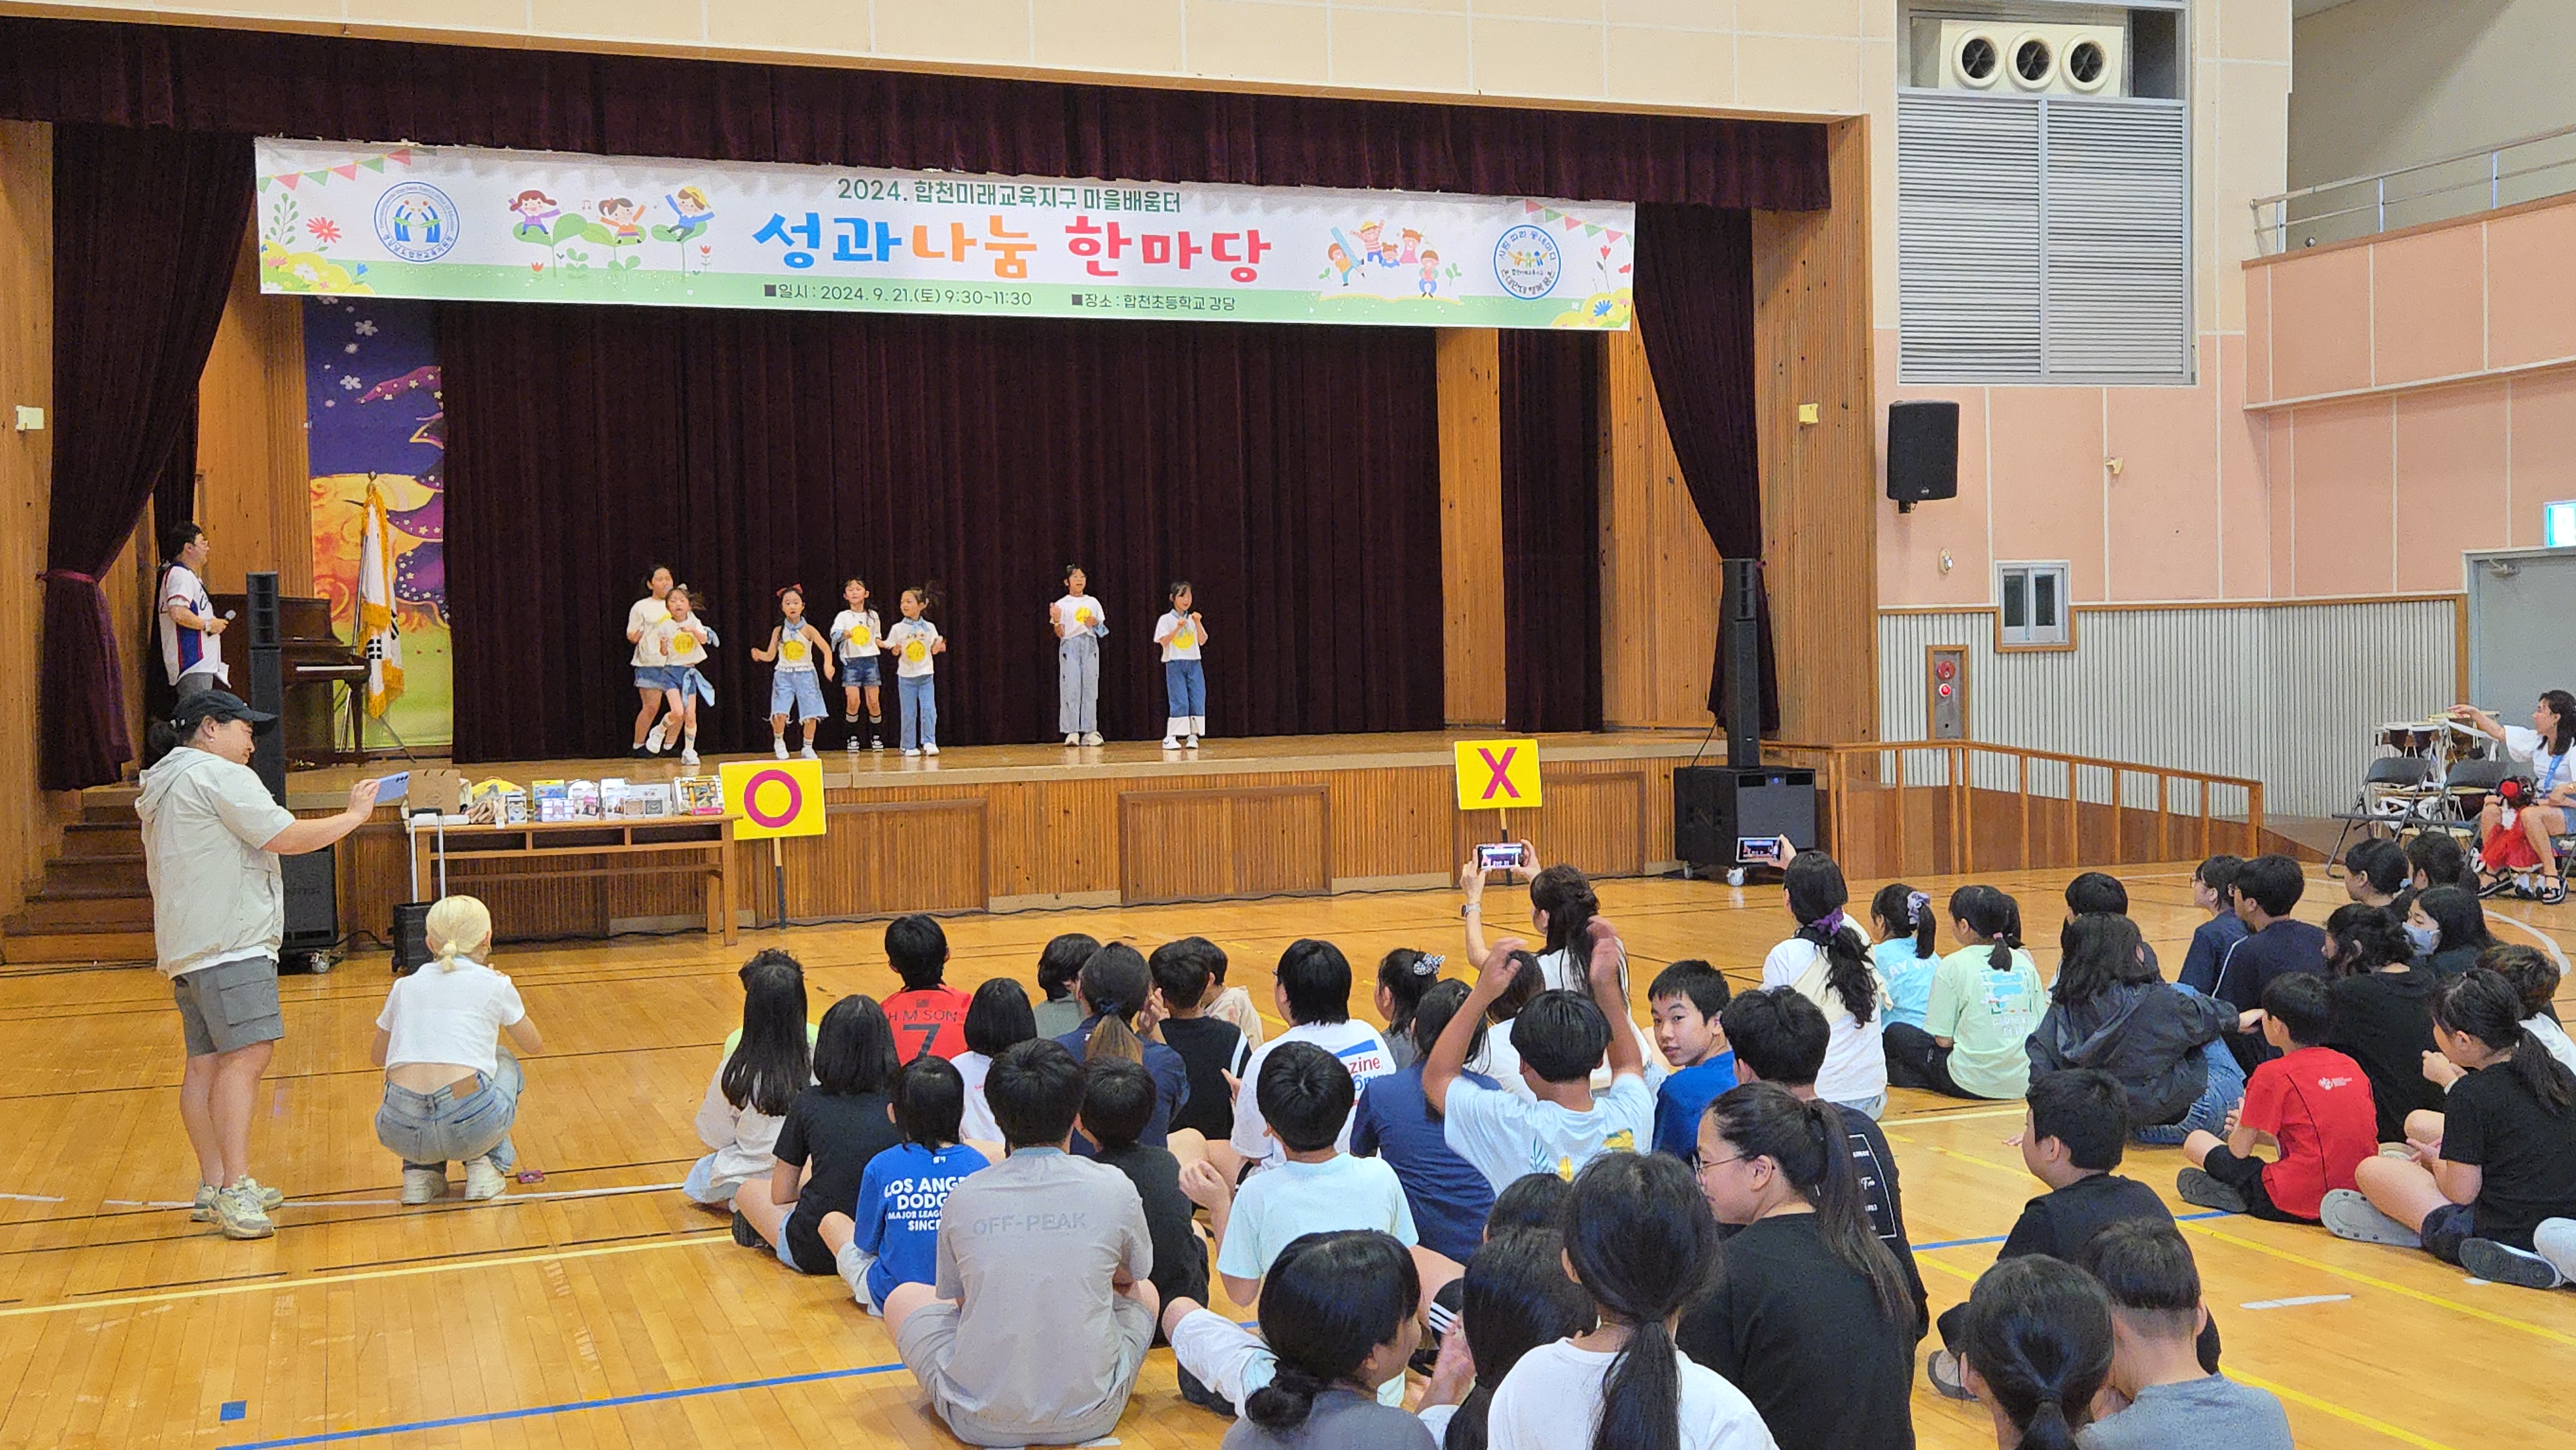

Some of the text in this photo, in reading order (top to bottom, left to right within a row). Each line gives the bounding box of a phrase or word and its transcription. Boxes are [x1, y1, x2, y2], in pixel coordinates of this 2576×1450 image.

[838, 178, 1182, 212] 2024. 합천미래교육지구 마을배움터
[752, 212, 1272, 283] 성과나눔 한마당
[821, 286, 869, 301] 2024.
[945, 290, 1032, 306] 9:30~11:30
[1124, 294, 1205, 310] 합천초등학교
[1209, 296, 1236, 312] 강당
[1477, 747, 1521, 799] X
[922, 1010, 958, 1022] SON
[903, 1023, 941, 1058] 7
[884, 1178, 914, 1198] LOS
[887, 1210, 917, 1219] MAJOR
[972, 1212, 1086, 1235] OFF-PEAK
